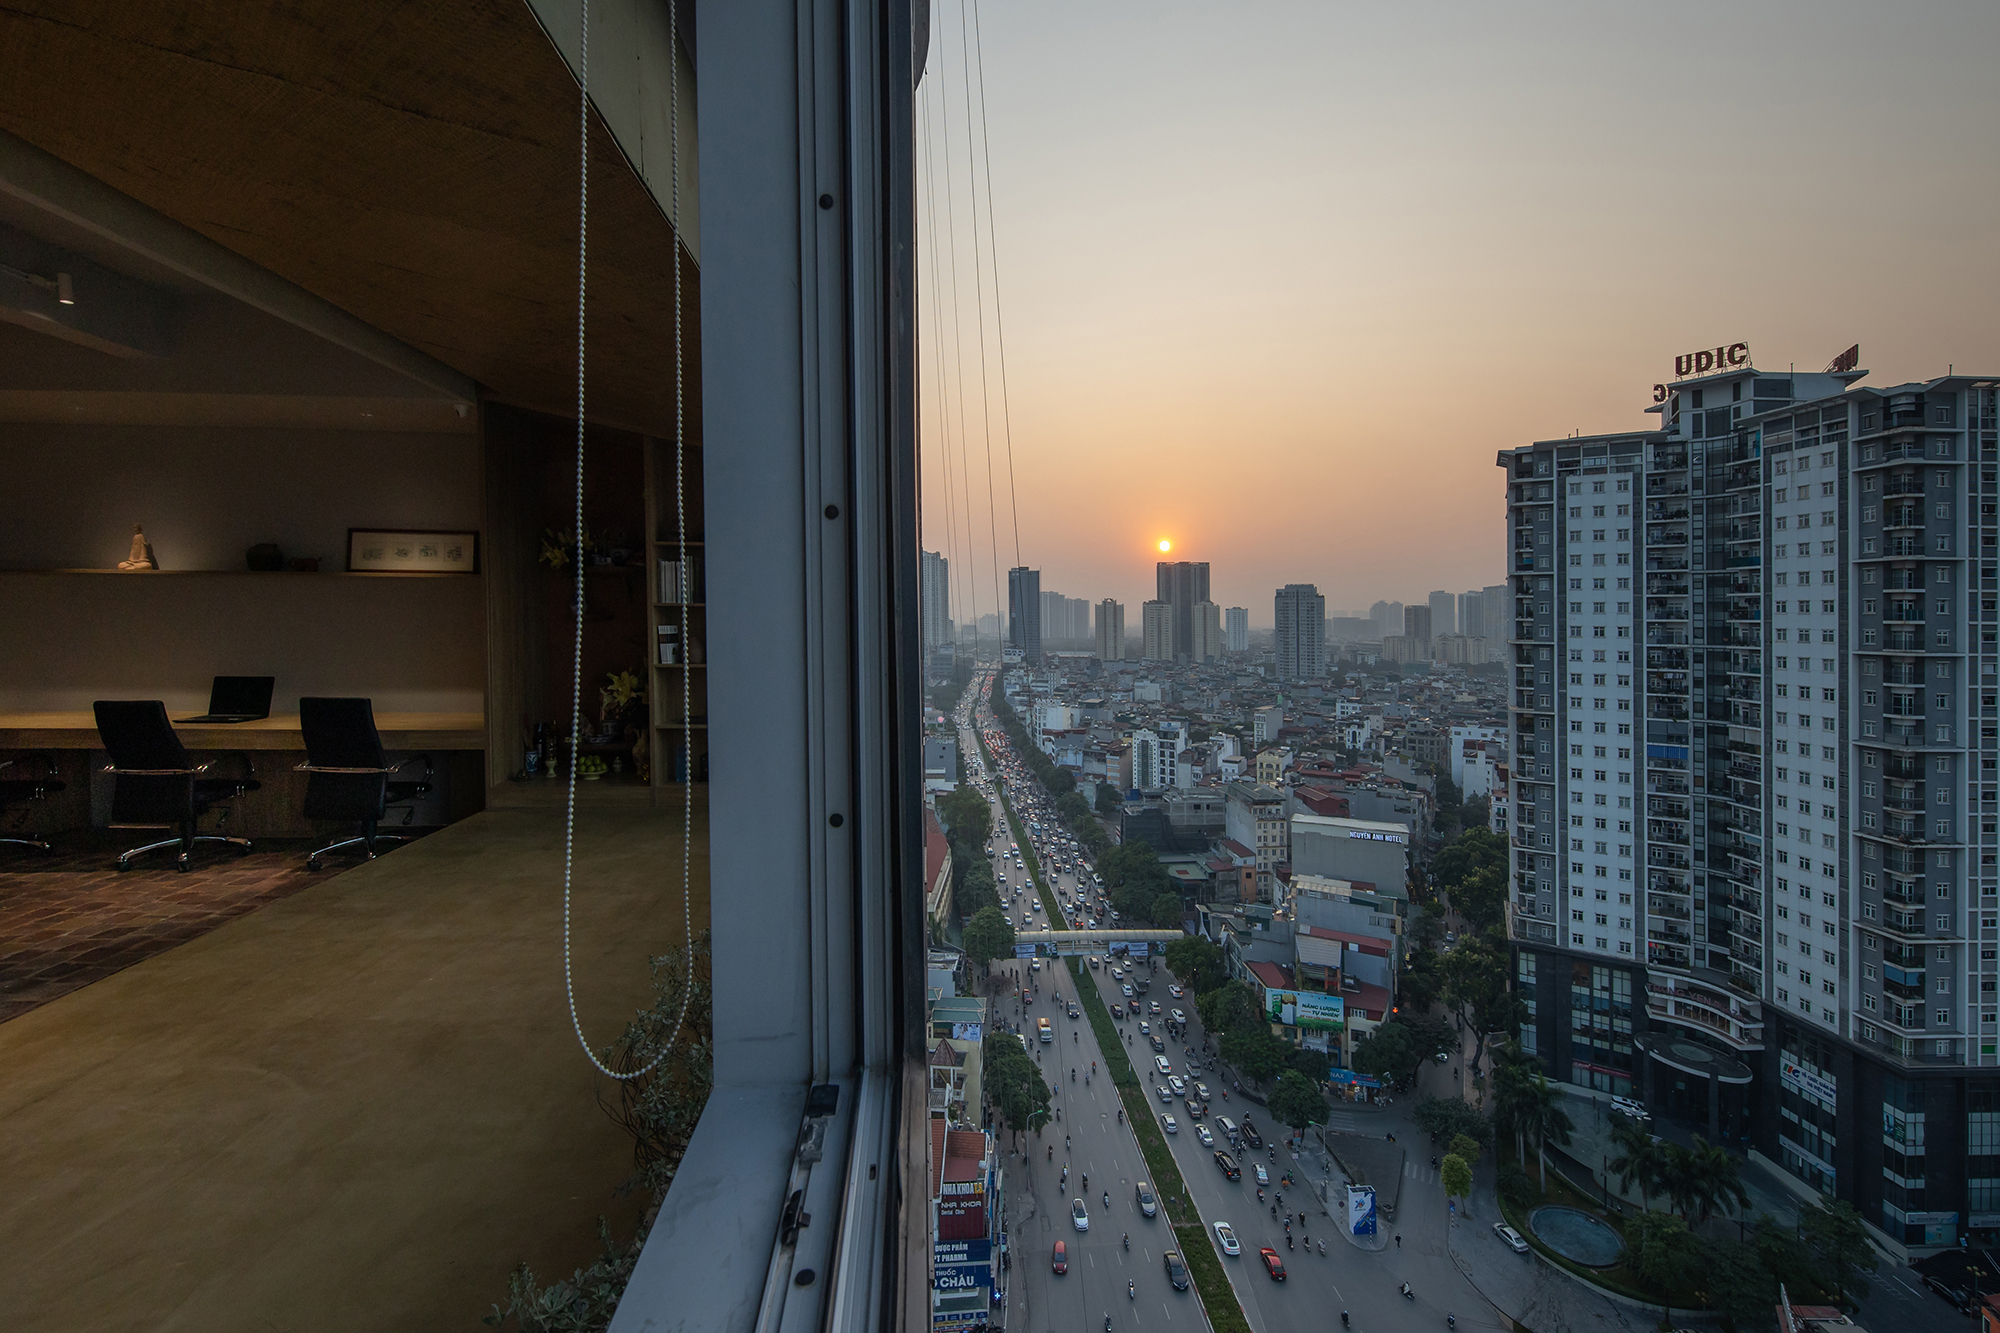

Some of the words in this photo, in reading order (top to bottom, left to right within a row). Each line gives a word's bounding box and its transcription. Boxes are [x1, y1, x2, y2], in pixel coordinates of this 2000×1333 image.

[1675, 342, 1747, 376] UDIC
[1372, 833, 1384, 841] ANH
[1385, 834, 1403, 843] HOTEL
[943, 1183, 957, 1195] NHA
[957, 1182, 974, 1195] KHOA
[941, 1253, 968, 1262] PHARMA
[936, 1268, 956, 1276] THUỐC
